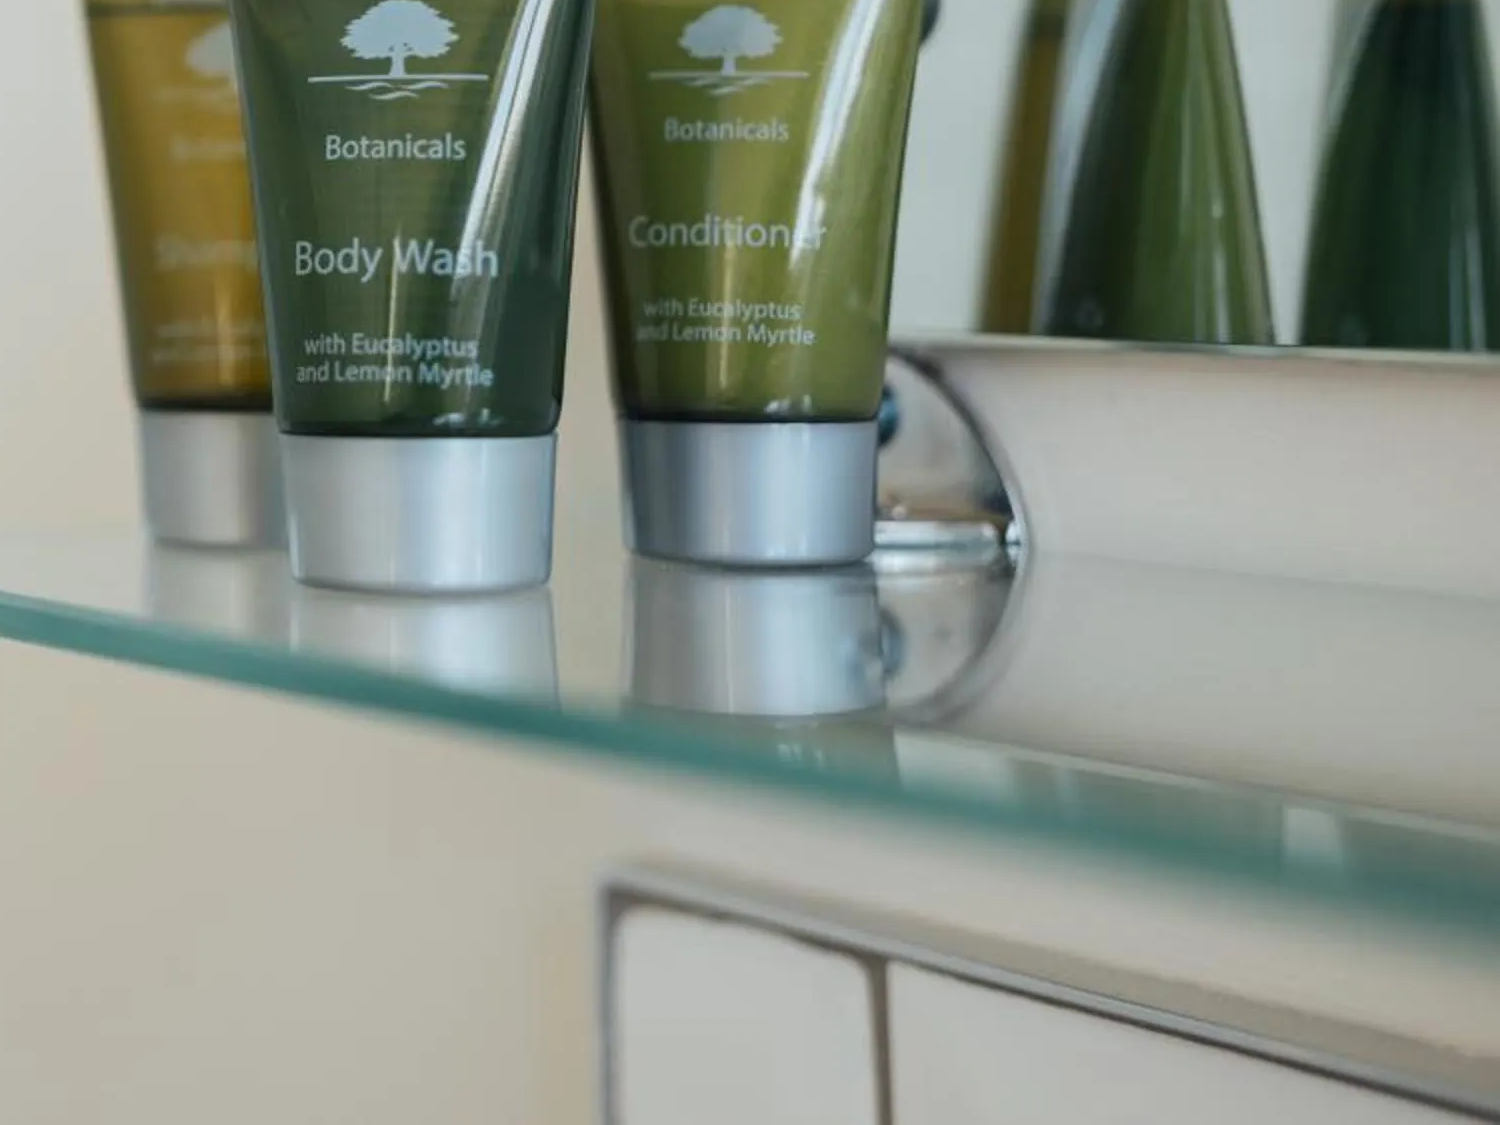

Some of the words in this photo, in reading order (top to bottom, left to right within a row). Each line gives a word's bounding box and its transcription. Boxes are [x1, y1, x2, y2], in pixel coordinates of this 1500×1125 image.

[664, 117, 790, 142] Botanicals
[324, 132, 467, 161] Botanicals
[295, 236, 383, 283] Body
[393, 236, 498, 278] Wash
[643, 299, 683, 318] with
[688, 299, 802, 322] Eucalyptus
[303, 334, 346, 356] with
[351, 332, 479, 361] Eucalyptus
[672, 324, 742, 343] Lemon
[747, 324, 816, 348] Myrtle
[296, 361, 329, 385] and
[334, 362, 412, 385] Lemon
[417, 363, 495, 390] Myrtle
